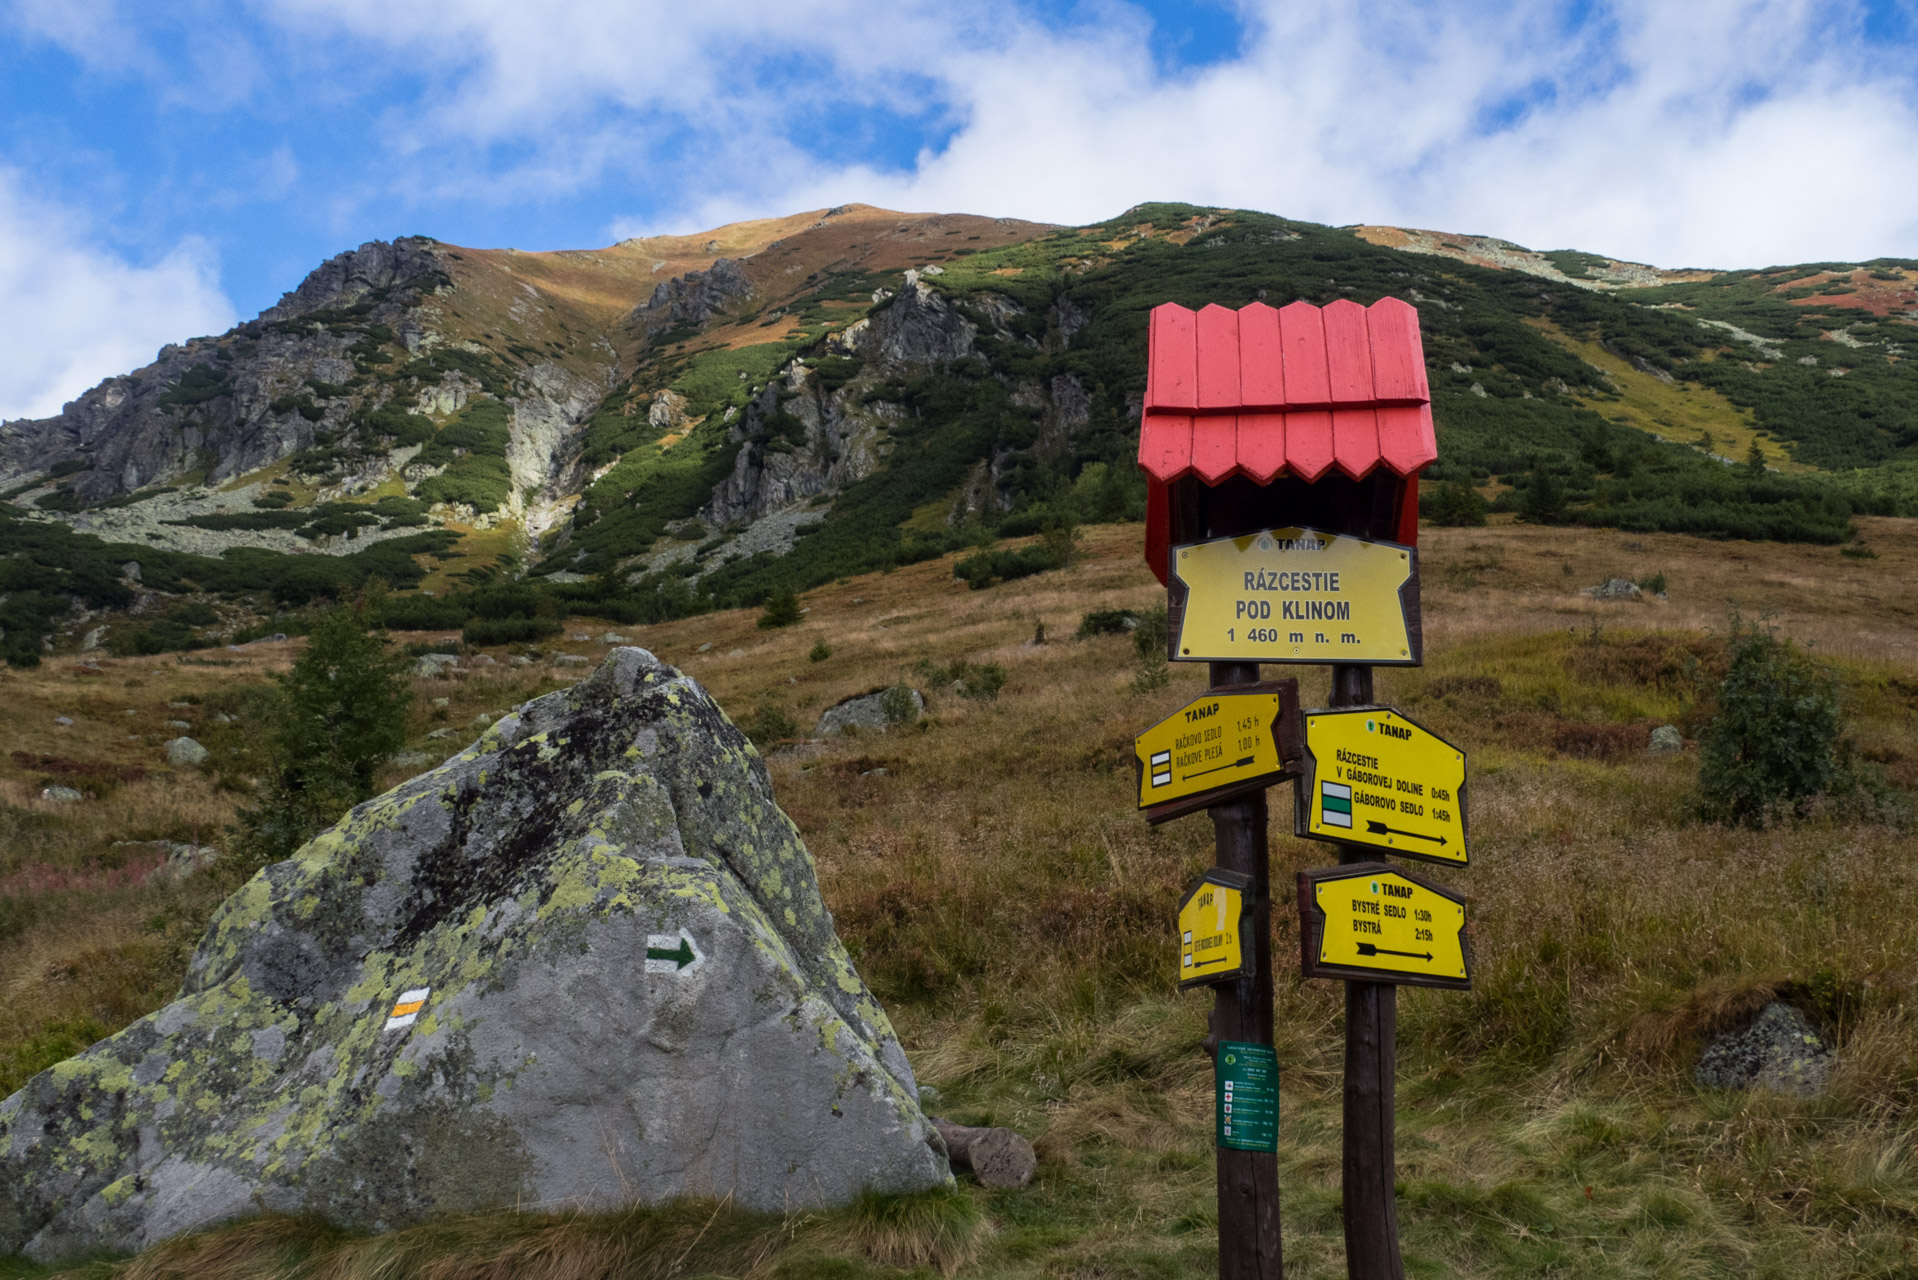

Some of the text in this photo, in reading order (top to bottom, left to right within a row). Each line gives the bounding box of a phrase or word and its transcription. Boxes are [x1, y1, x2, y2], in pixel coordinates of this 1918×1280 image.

[1276, 538, 1326, 551] TANAP
[1244, 567, 1340, 592] RÁZCESTIE
[1236, 600, 1351, 621] POD KLINOM
[1227, 628, 1361, 644] 1 460 m n. m.
[1185, 703, 1219, 723] TANAP
[1204, 726, 1222, 743] SEDLO
[1378, 722, 1412, 741] TANAP
[1336, 748, 1379, 770] RÁZCESTIE
[1336, 766, 1450, 802] V GÁBOROVEJ DOLINE 0:45h
[1354, 790, 1451, 823] GÁBOROVO SEDLO 1:45h
[1381, 883, 1413, 899] TANAP
[1352, 899, 1432, 922] BYSTRÉ SEDLO 1:30h
[1352, 919, 1433, 942] BYSTRÁ 2:15h
